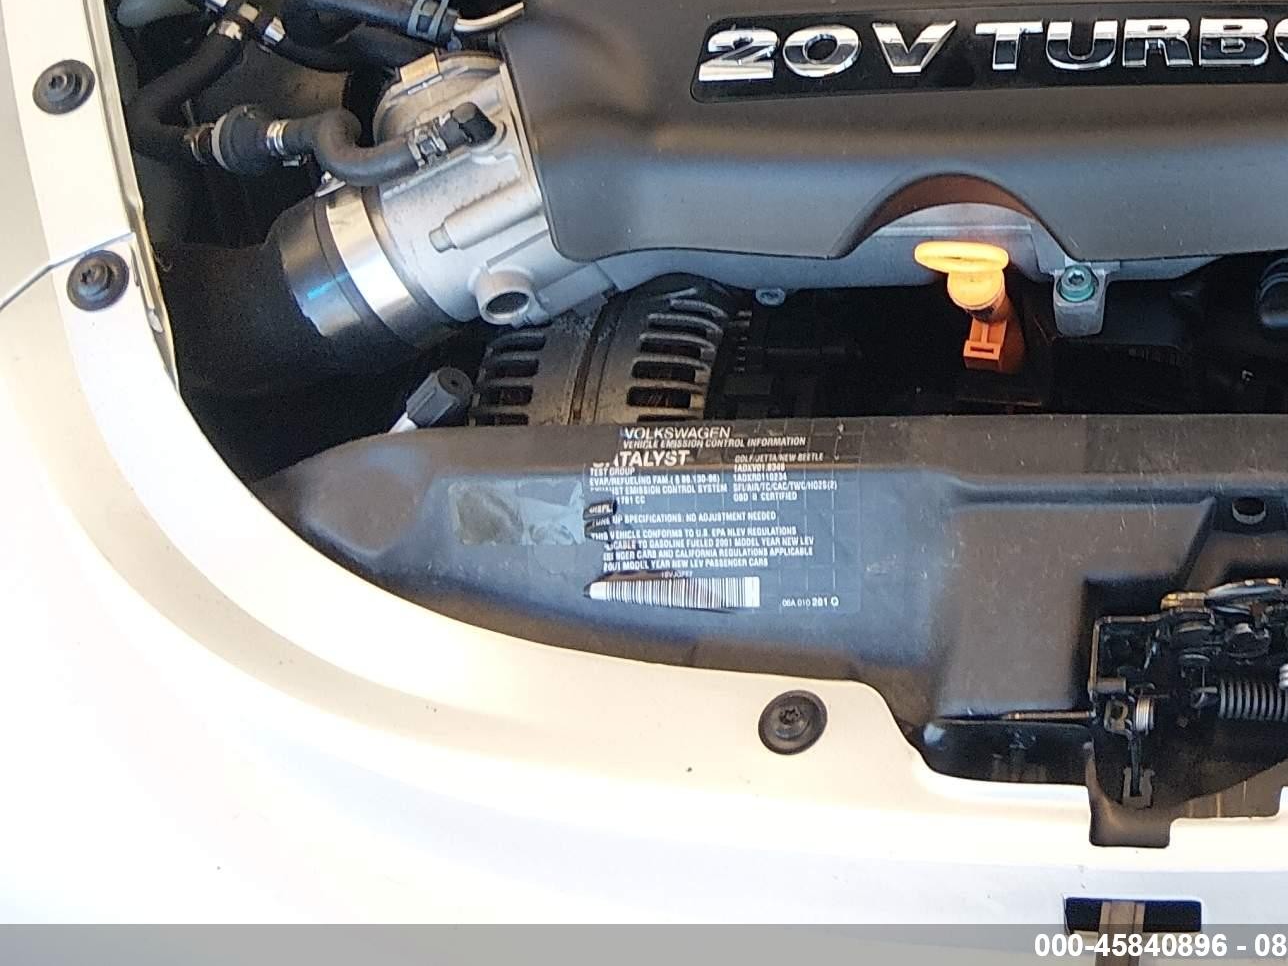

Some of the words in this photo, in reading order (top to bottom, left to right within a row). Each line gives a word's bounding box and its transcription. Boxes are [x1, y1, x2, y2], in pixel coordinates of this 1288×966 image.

[699, 19, 958, 82] 20V
[625, 426, 731, 439] VOLKSWAGEN
[623, 439, 658, 449] VEHICLE
[661, 439, 704, 448] EMISSION
[705, 438, 745, 448] CONTROL
[747, 437, 807, 448] INFORMATION
[798, 452, 824, 462] BEETLE
[609, 467, 635, 476] GROUP
[625, 485, 661, 495] EMISSION
[662, 485, 696, 495] CONTROL
[697, 484, 728, 494] SYSTEM
[760, 491, 798, 501] CERTIFIED
[612, 515, 623, 524] UP
[685, 513, 697, 522] NO
[698, 512, 746, 522] ADJUSTMENT
[748, 511, 777, 521] NEEDED
[610, 530, 641, 540] VEHICLE
[642, 529, 684, 539] CONFORMS
[684, 529, 694, 538] TO
[711, 528, 726, 537] EPA
[747, 526, 797, 536] REGULATIONS
[649, 539, 686, 548] GASOLINE
[686, 538, 714, 548] FUELED
[734, 537, 760, 547] MODEL
[761, 536, 781, 546] YEAR
[782, 536, 799, 546] NEW
[800, 535, 814, 546] LEV
[658, 549, 674, 559] AND
[675, 548, 718, 558] CALIFORNIA
[719, 548, 769, 558] REGULATIONS
[769, 547, 814, 557] APPLICABLE
[651, 560, 671, 570] YEAR
[672, 559, 689, 568] NEW
[690, 559, 704, 568] LEV
[705, 558, 748, 568] PASSENGER
[749, 558, 769, 567] CARS
